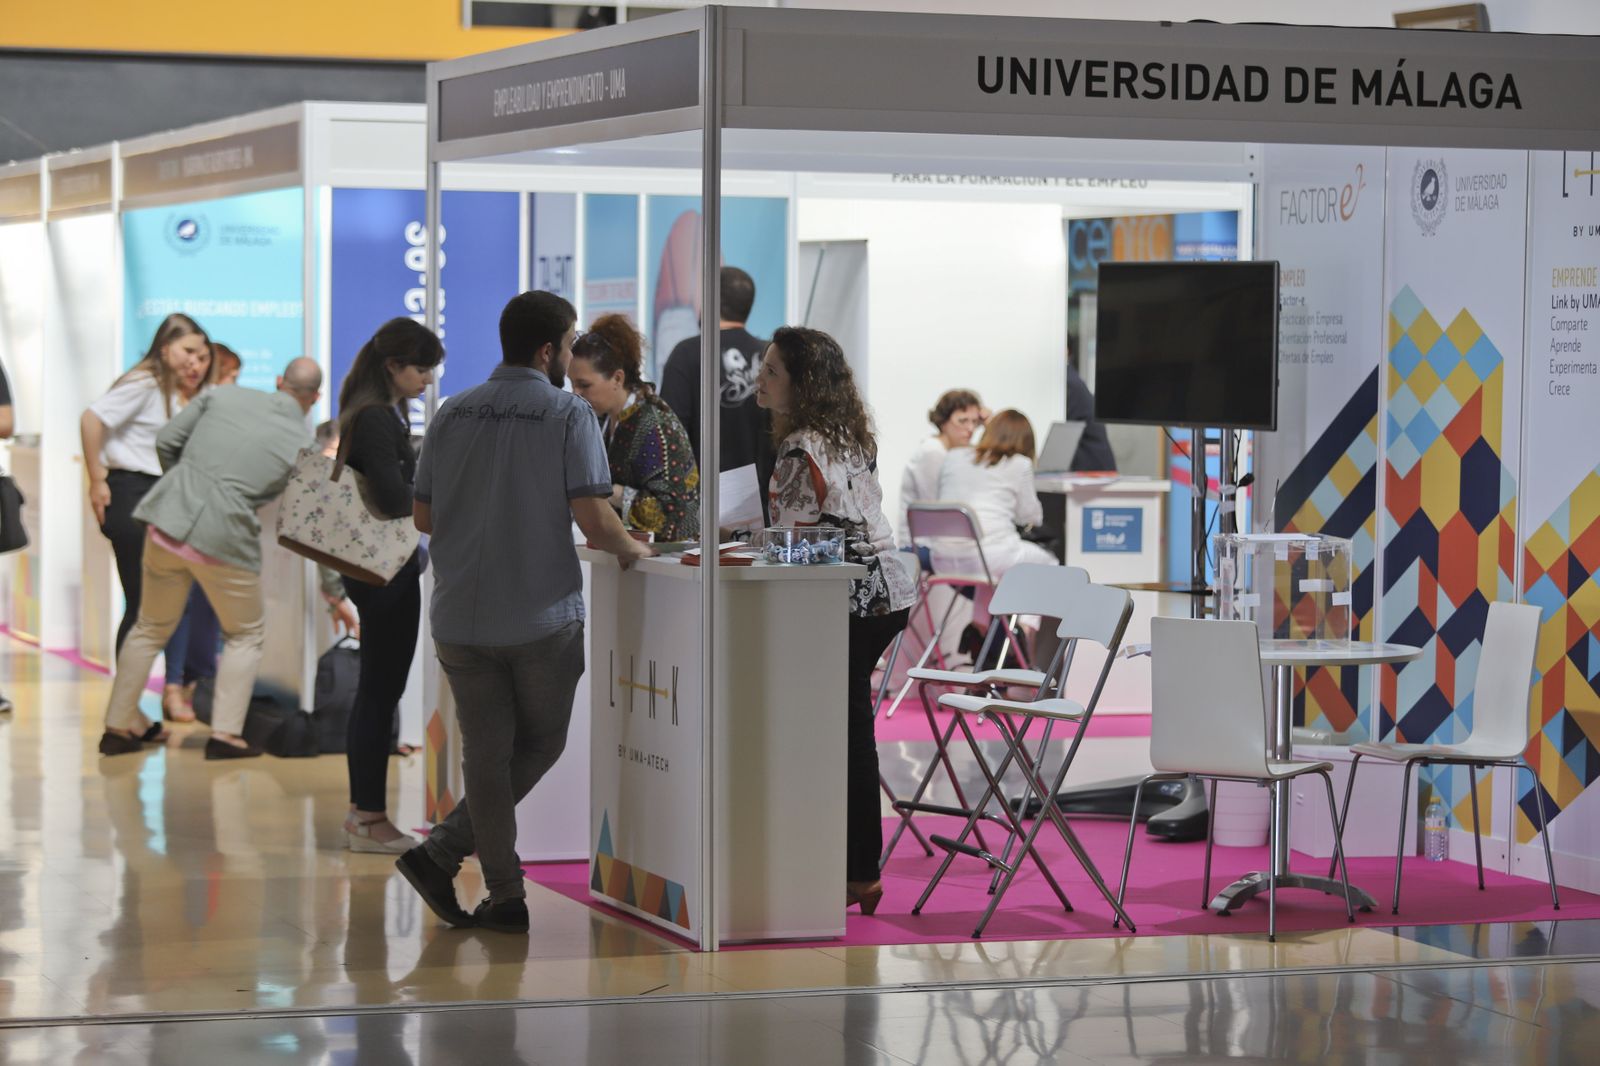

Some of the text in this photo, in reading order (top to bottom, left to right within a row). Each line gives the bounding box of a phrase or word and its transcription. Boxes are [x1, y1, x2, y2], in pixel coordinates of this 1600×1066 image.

[609, 67, 626, 100] UMA
[977, 55, 1523, 110] UNIVERSIDAD DE MÁLAGA
[1454, 173, 1508, 192] UNIVERSIDAD
[1454, 192, 1500, 212] DE MÁLAGA
[1572, 226, 1584, 237] BY
[1551, 266, 1598, 289] EMPRENDE
[1551, 293, 1568, 310] Link
[1570, 293, 1580, 312] by
[1550, 315, 1589, 334] Comparte
[1549, 337, 1582, 355] Aprende
[1549, 358, 1598, 377] Experimenta
[1548, 380, 1571, 396] Crece
[608, 648, 680, 727] LINK
[618, 743, 669, 773] BY UMA-ATECH
